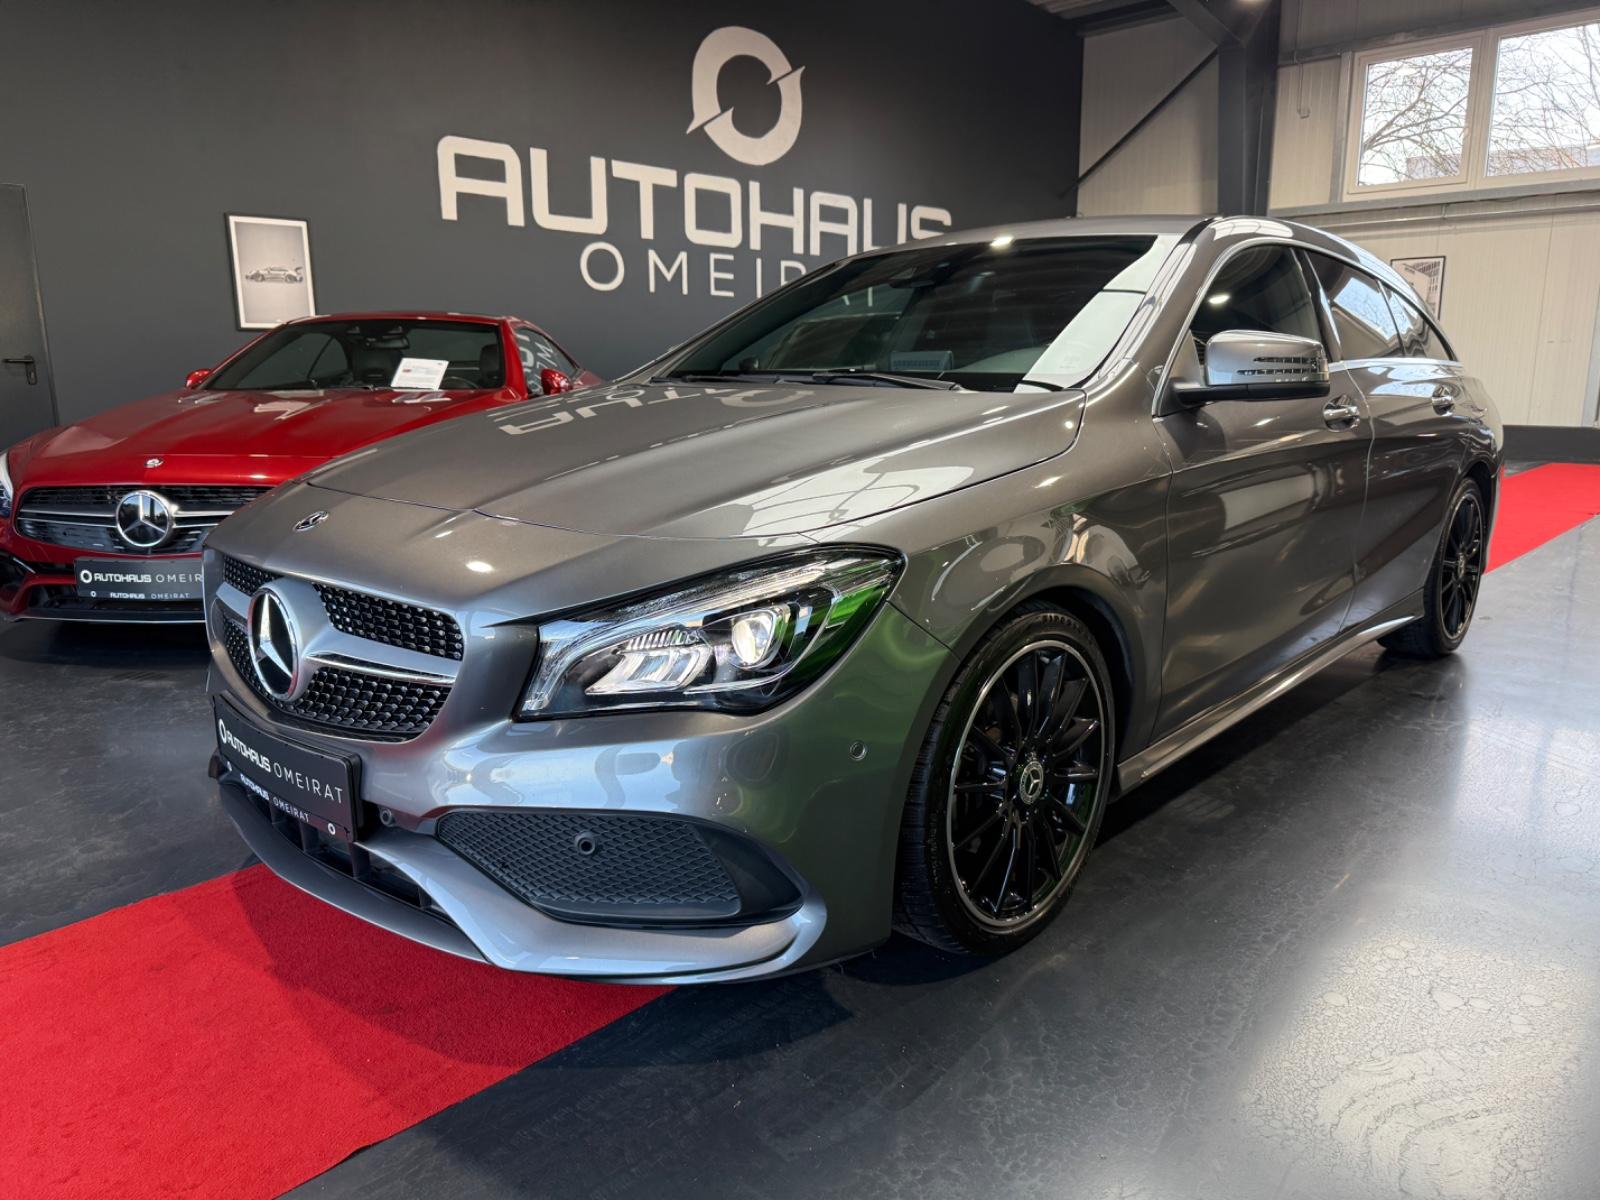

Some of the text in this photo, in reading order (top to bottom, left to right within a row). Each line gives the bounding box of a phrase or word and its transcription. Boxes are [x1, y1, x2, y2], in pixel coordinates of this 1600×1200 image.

[437, 135, 952, 256] AUTOHAUS
[580, 241, 874, 306] OMEIR
[93, 572, 202, 583] AUTOHAUS OMEIR
[226, 732, 343, 804] AUTOHAUS OMEIRAT
[272, 796, 309, 823] OMEIRAT
